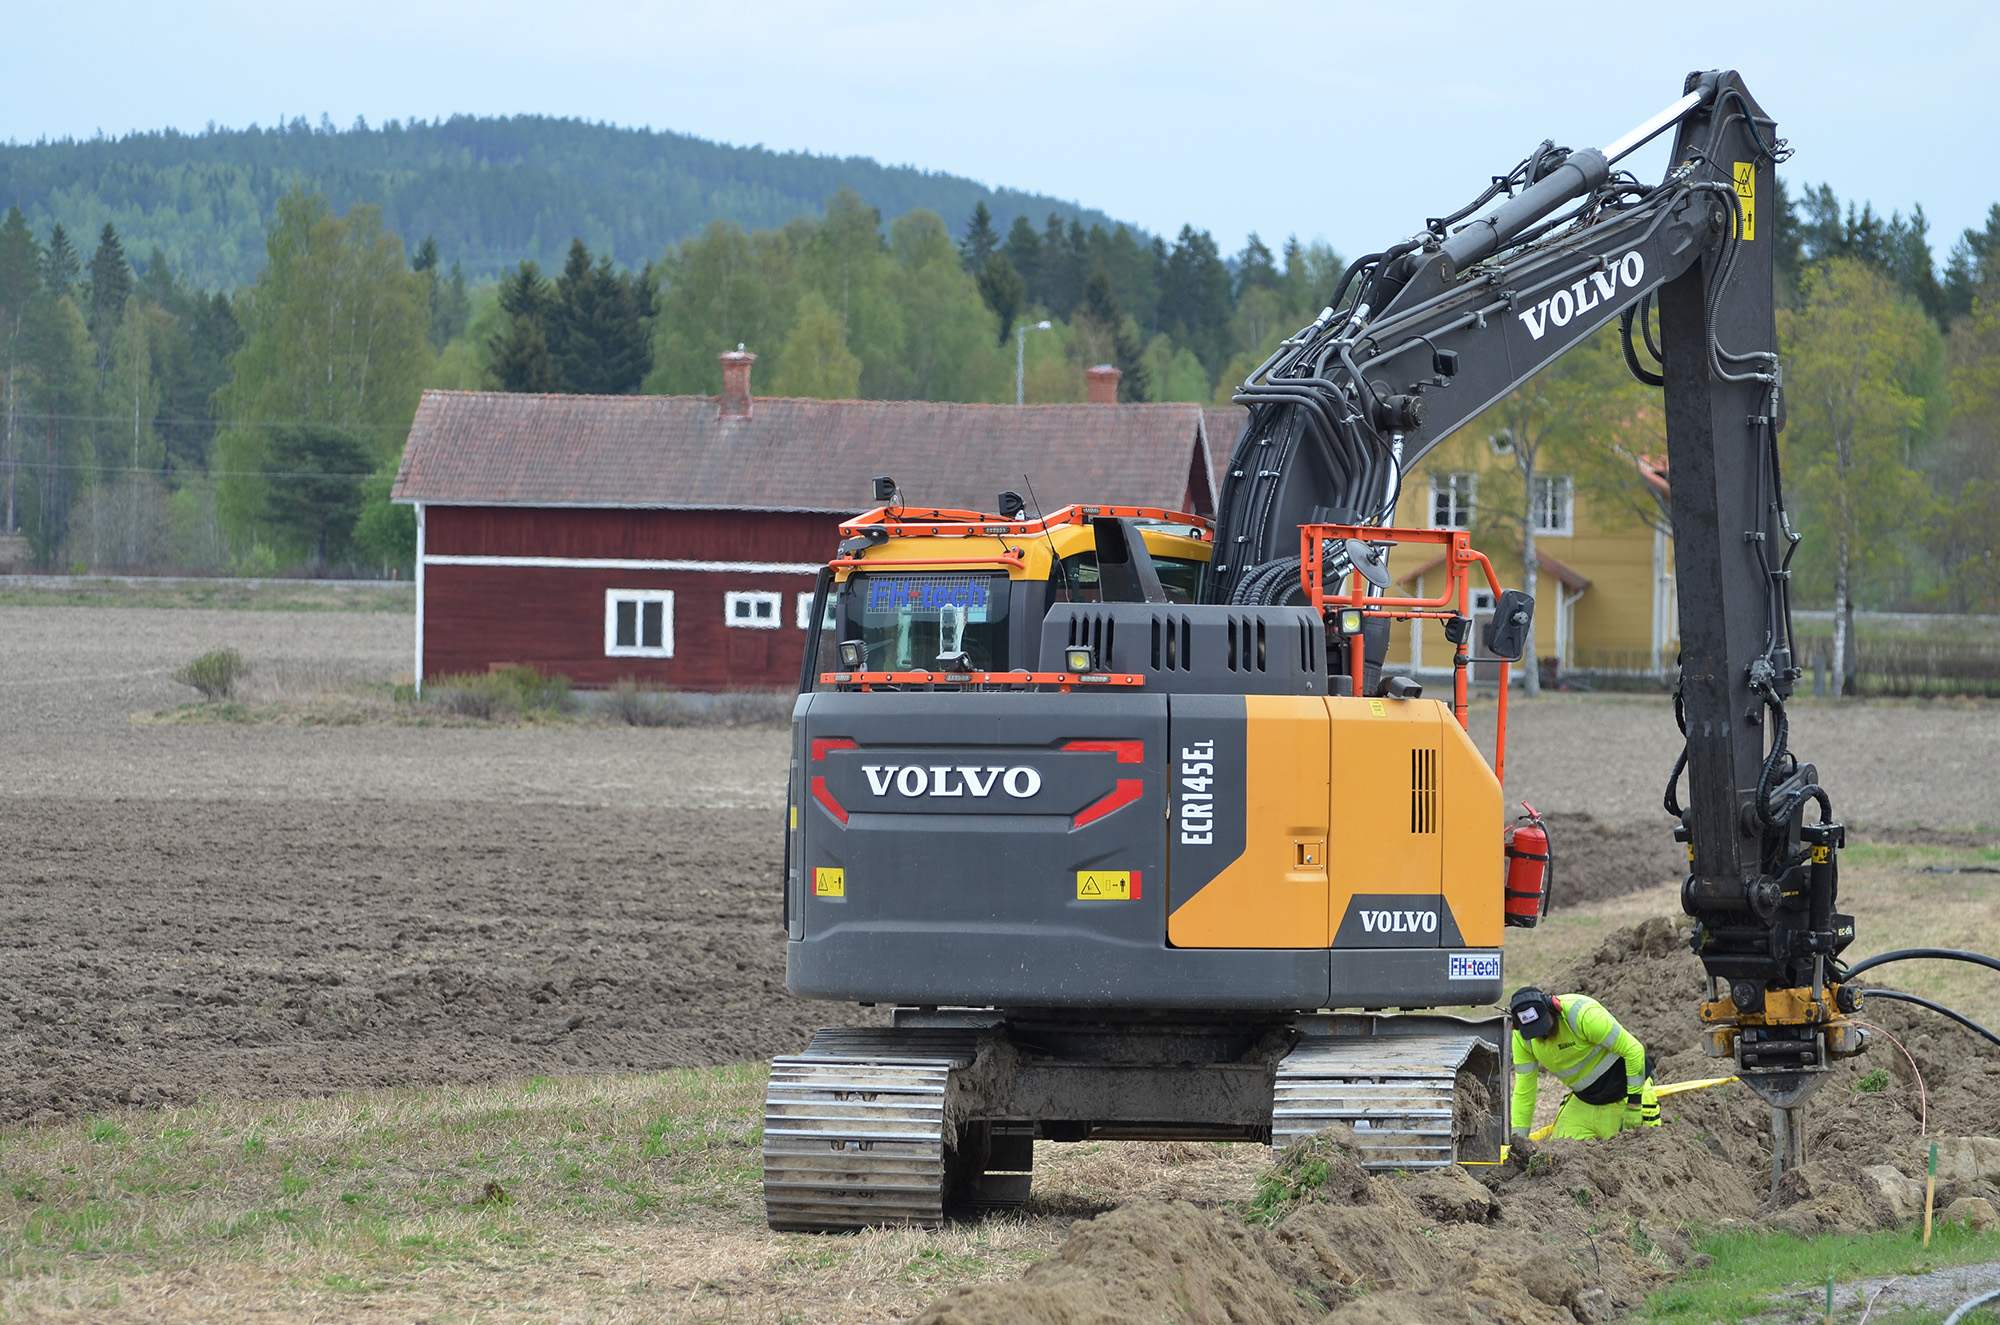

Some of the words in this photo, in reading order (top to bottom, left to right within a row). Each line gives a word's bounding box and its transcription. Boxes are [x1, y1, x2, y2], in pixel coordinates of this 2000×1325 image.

[1518, 250, 1645, 341] VOLVO
[870, 580, 985, 609] FH-tech
[861, 764, 1042, 799] VOLVO
[1359, 910, 1438, 933] VOLVO
[1450, 957, 1499, 976] FH-tech
